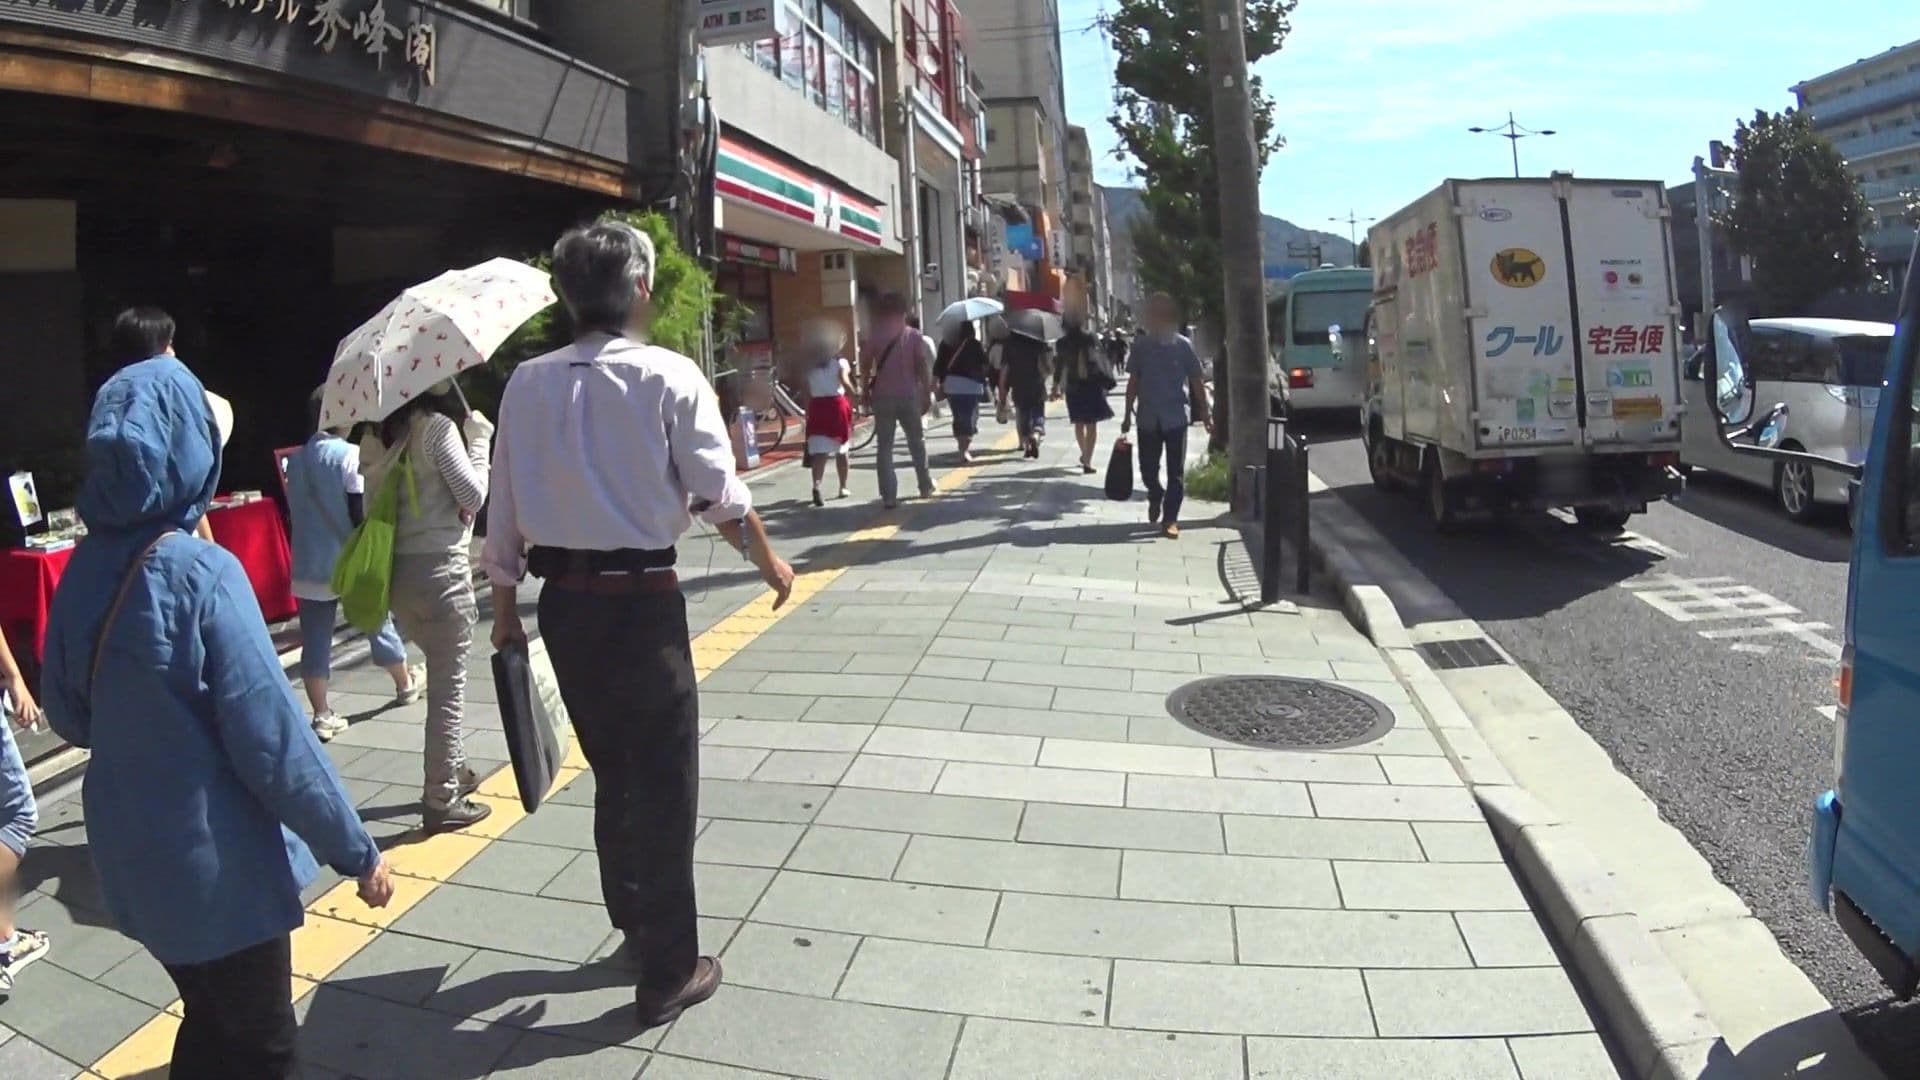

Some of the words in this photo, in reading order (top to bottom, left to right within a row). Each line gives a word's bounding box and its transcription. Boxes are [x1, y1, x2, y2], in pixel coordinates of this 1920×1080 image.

[703, 14, 724, 29] ATM
[1485, 325, 1564, 358] クール
[1588, 324, 1665, 355] 宅急便
